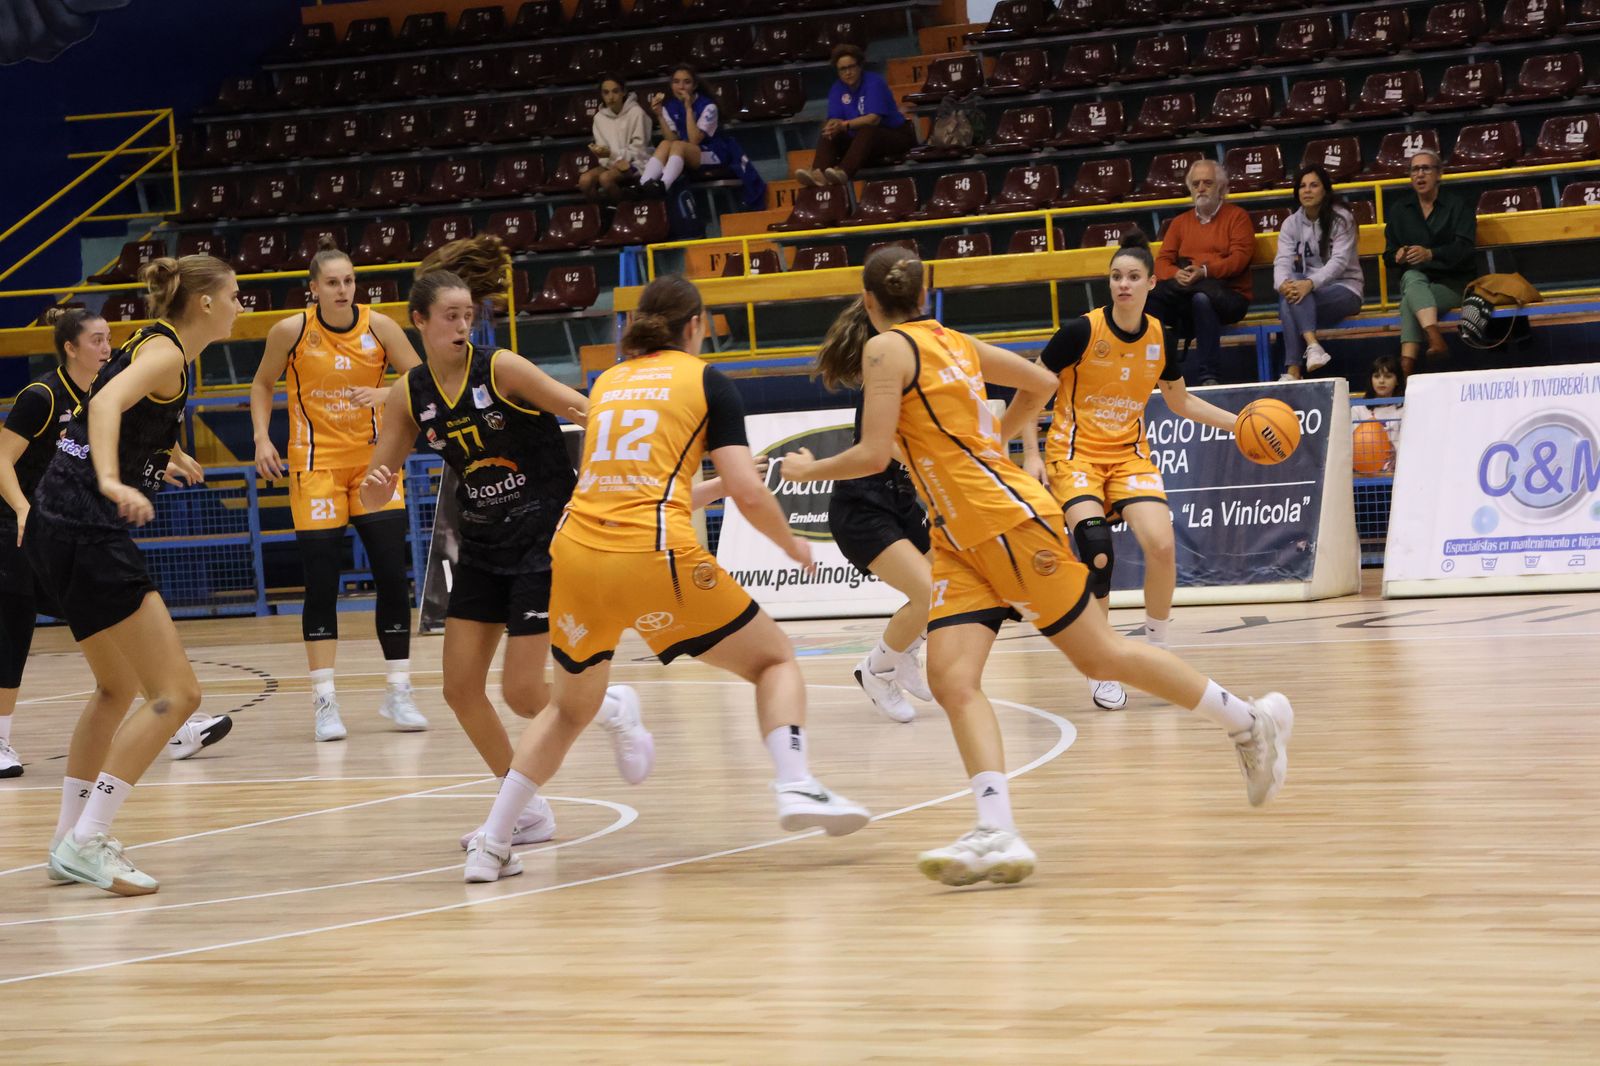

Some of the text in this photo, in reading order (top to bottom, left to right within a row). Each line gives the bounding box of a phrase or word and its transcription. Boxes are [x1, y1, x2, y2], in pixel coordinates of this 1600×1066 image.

[1299, 23, 1315, 34] 50
[773, 30, 788, 40] 64
[1226, 33, 1241, 43] 52
[1153, 41, 1169, 52] 54
[1084, 49, 1100, 60] 56
[775, 80, 790, 90] 62
[1162, 100, 1179, 111] 52
[400, 115, 415, 125] 74
[1020, 114, 1035, 124] 56
[1566, 119, 1588, 134] 40
[226, 129, 241, 140] 80
[1481, 129, 1500, 141] 42
[1325, 144, 1342, 155] 46
[451, 165, 466, 175] 70
[513, 160, 528, 170] 68
[1171, 159, 1188, 170] 50
[390, 170, 405, 181] 72
[1098, 166, 1114, 176] 52
[330, 176, 344, 186] 74
[816, 191, 832, 201] 60
[882, 185, 898, 196] 58
[1502, 195, 1521, 207] 40
[569, 211, 586, 221] 64
[634, 206, 649, 216] 62
[505, 217, 520, 227] 66
[1260, 215, 1279, 228] 46
[381, 227, 395, 237] 70
[1104, 229, 1120, 241] 50
[197, 241, 212, 252] 76
[259, 236, 274, 248] 74
[1030, 236, 1046, 246] 52
[565, 272, 580, 283] 62
[368, 287, 382, 298] 68
[242, 296, 257, 307] 72
[120, 303, 135, 315] 76
[334, 355, 352, 370] 21
[1120, 367, 1131, 381] 3
[311, 386, 353, 399] recole
[1460, 377, 1519, 402] LAVANDERÍA
[1523, 380, 1531, 398] Y
[1532, 372, 1589, 398] TINTORERÍA
[600, 387, 671, 404] BRATKA
[590, 409, 660, 463] 12
[1146, 418, 1195, 445] ACIO
[447, 424, 485, 459] 77
[311, 498, 337, 520] 21
[788, 511, 829, 524] Embuti
[1445, 540, 1498, 555] Especialistas
[97, 781, 114, 794] 23
